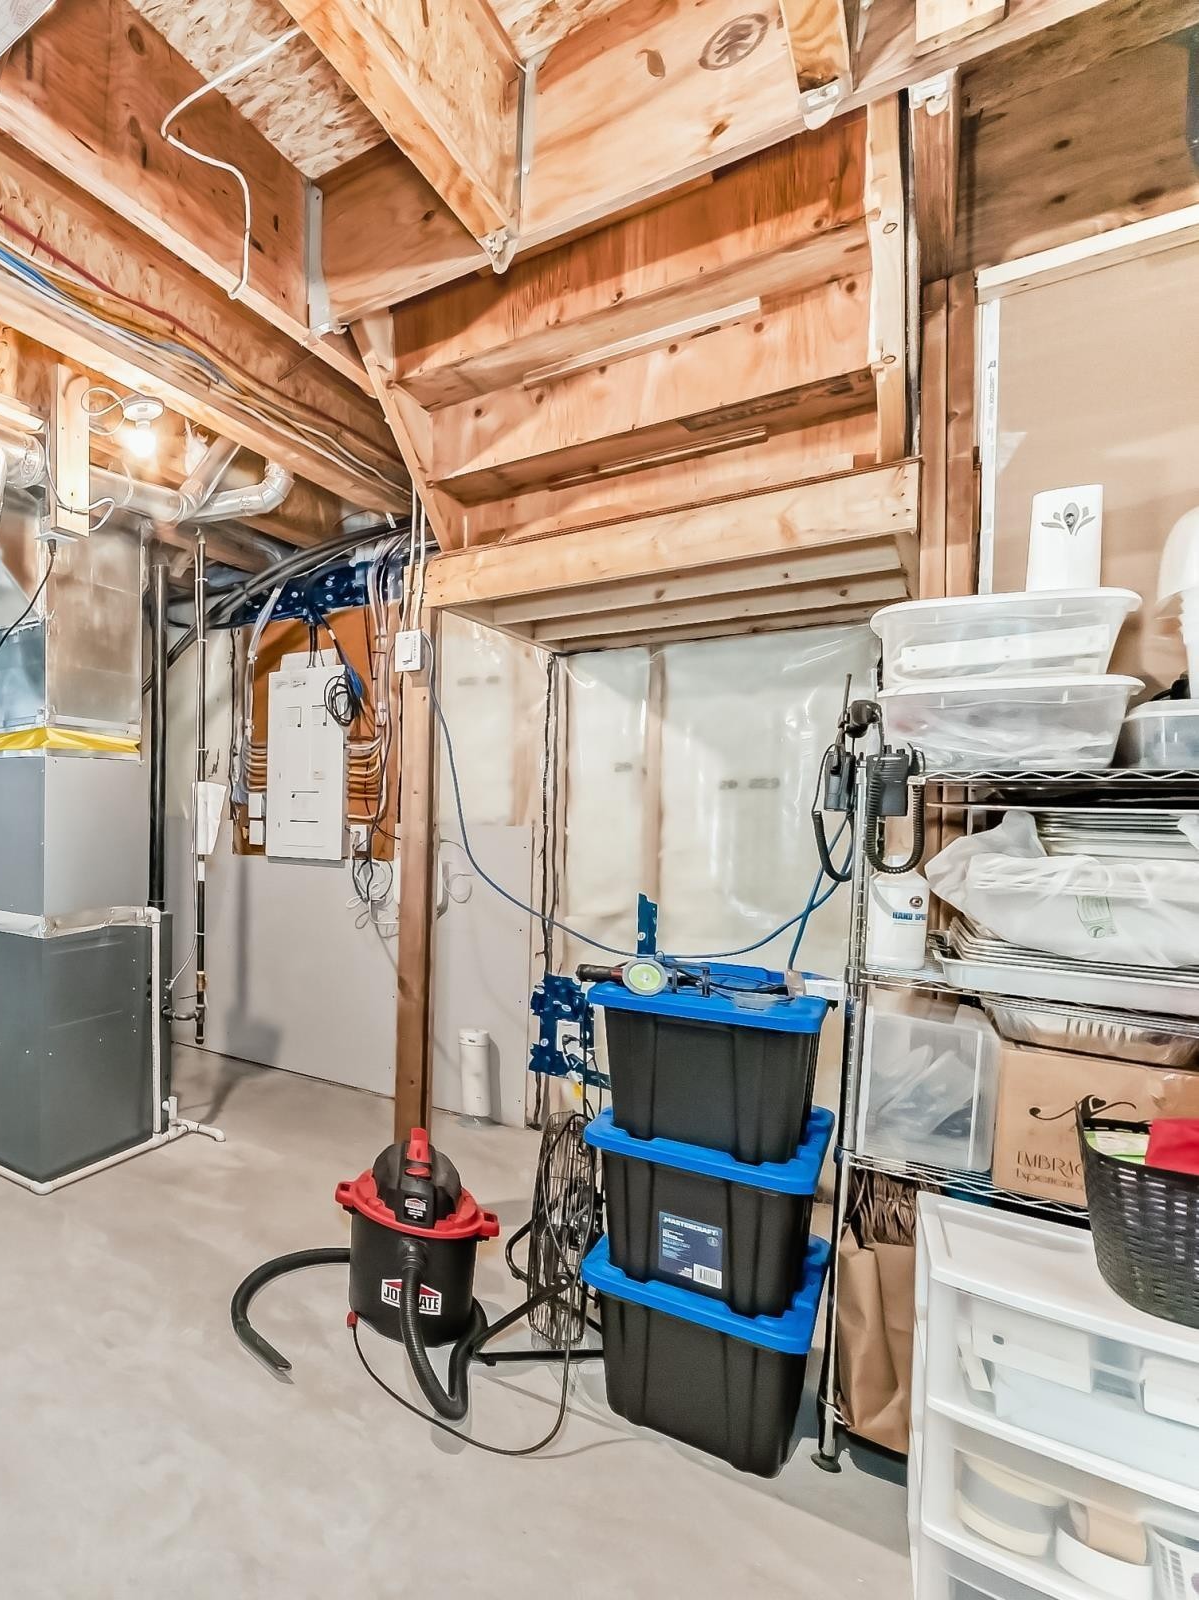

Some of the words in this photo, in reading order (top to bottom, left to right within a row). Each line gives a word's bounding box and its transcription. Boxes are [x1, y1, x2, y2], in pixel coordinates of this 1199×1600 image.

[892, 911, 913, 921] HAND
[1017, 1150, 1083, 1179] EMBRAC
[663, 1216, 719, 1236] MASTERCRAFT
[384, 1287, 440, 1310] JOATE
